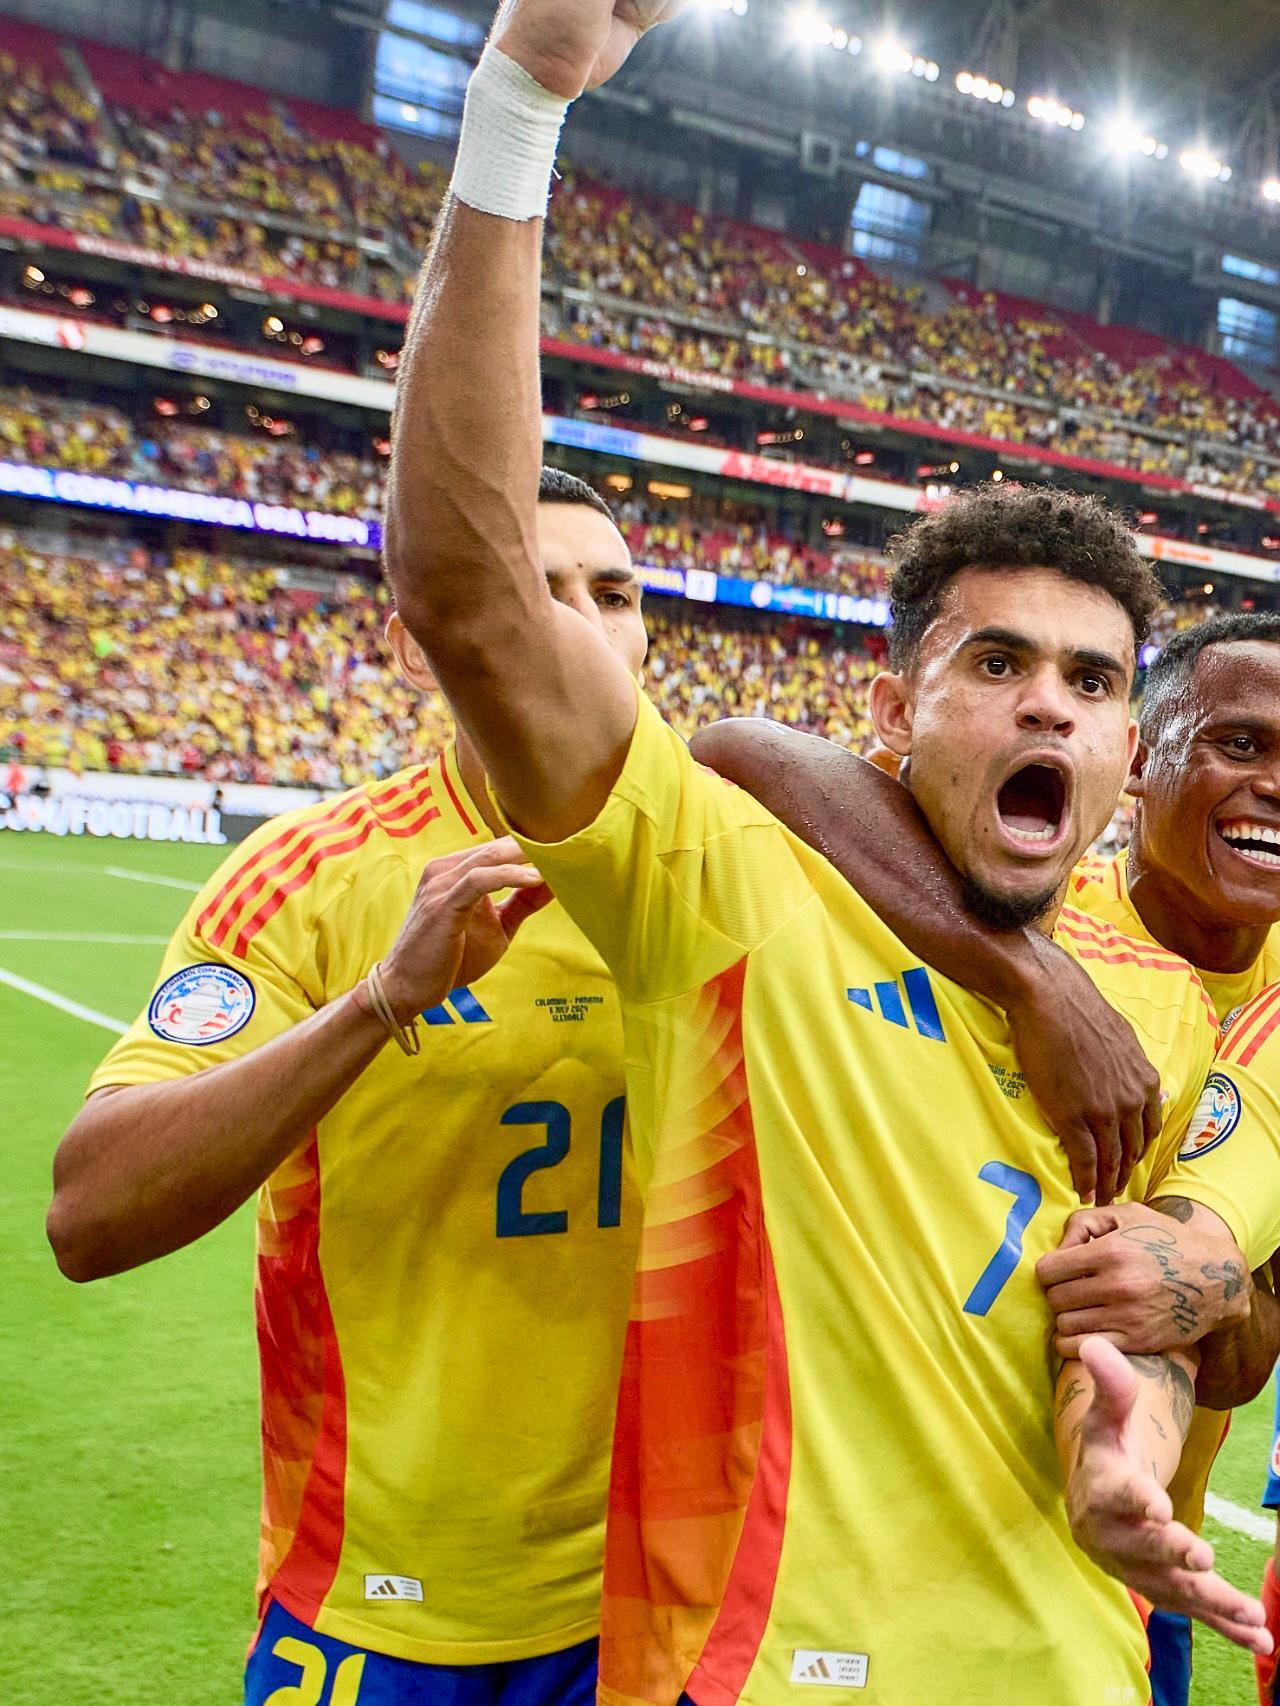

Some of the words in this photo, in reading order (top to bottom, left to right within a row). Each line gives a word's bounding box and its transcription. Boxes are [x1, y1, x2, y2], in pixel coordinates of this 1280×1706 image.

[496, 1095, 626, 1238] 21
[961, 1160, 1043, 1318] 7
[263, 1635, 367, 1706] 21
